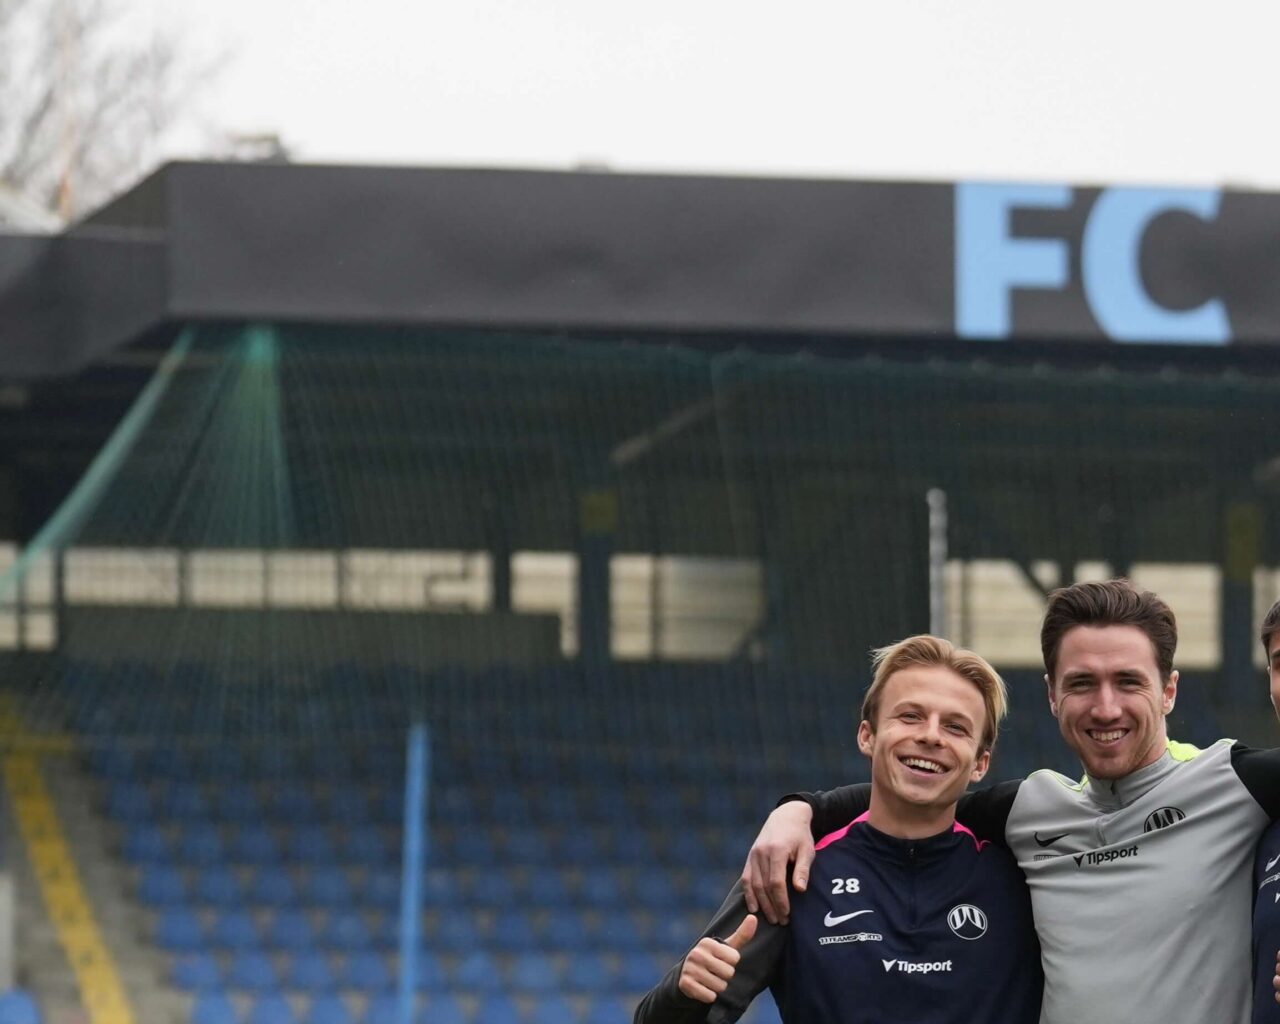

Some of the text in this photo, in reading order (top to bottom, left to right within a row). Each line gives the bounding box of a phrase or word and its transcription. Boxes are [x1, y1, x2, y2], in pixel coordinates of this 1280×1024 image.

[954, 180, 1231, 345] FC
[1086, 845, 1139, 865] Tipsport
[831, 878, 860, 895] 28
[897, 959, 953, 974] Tipsport
